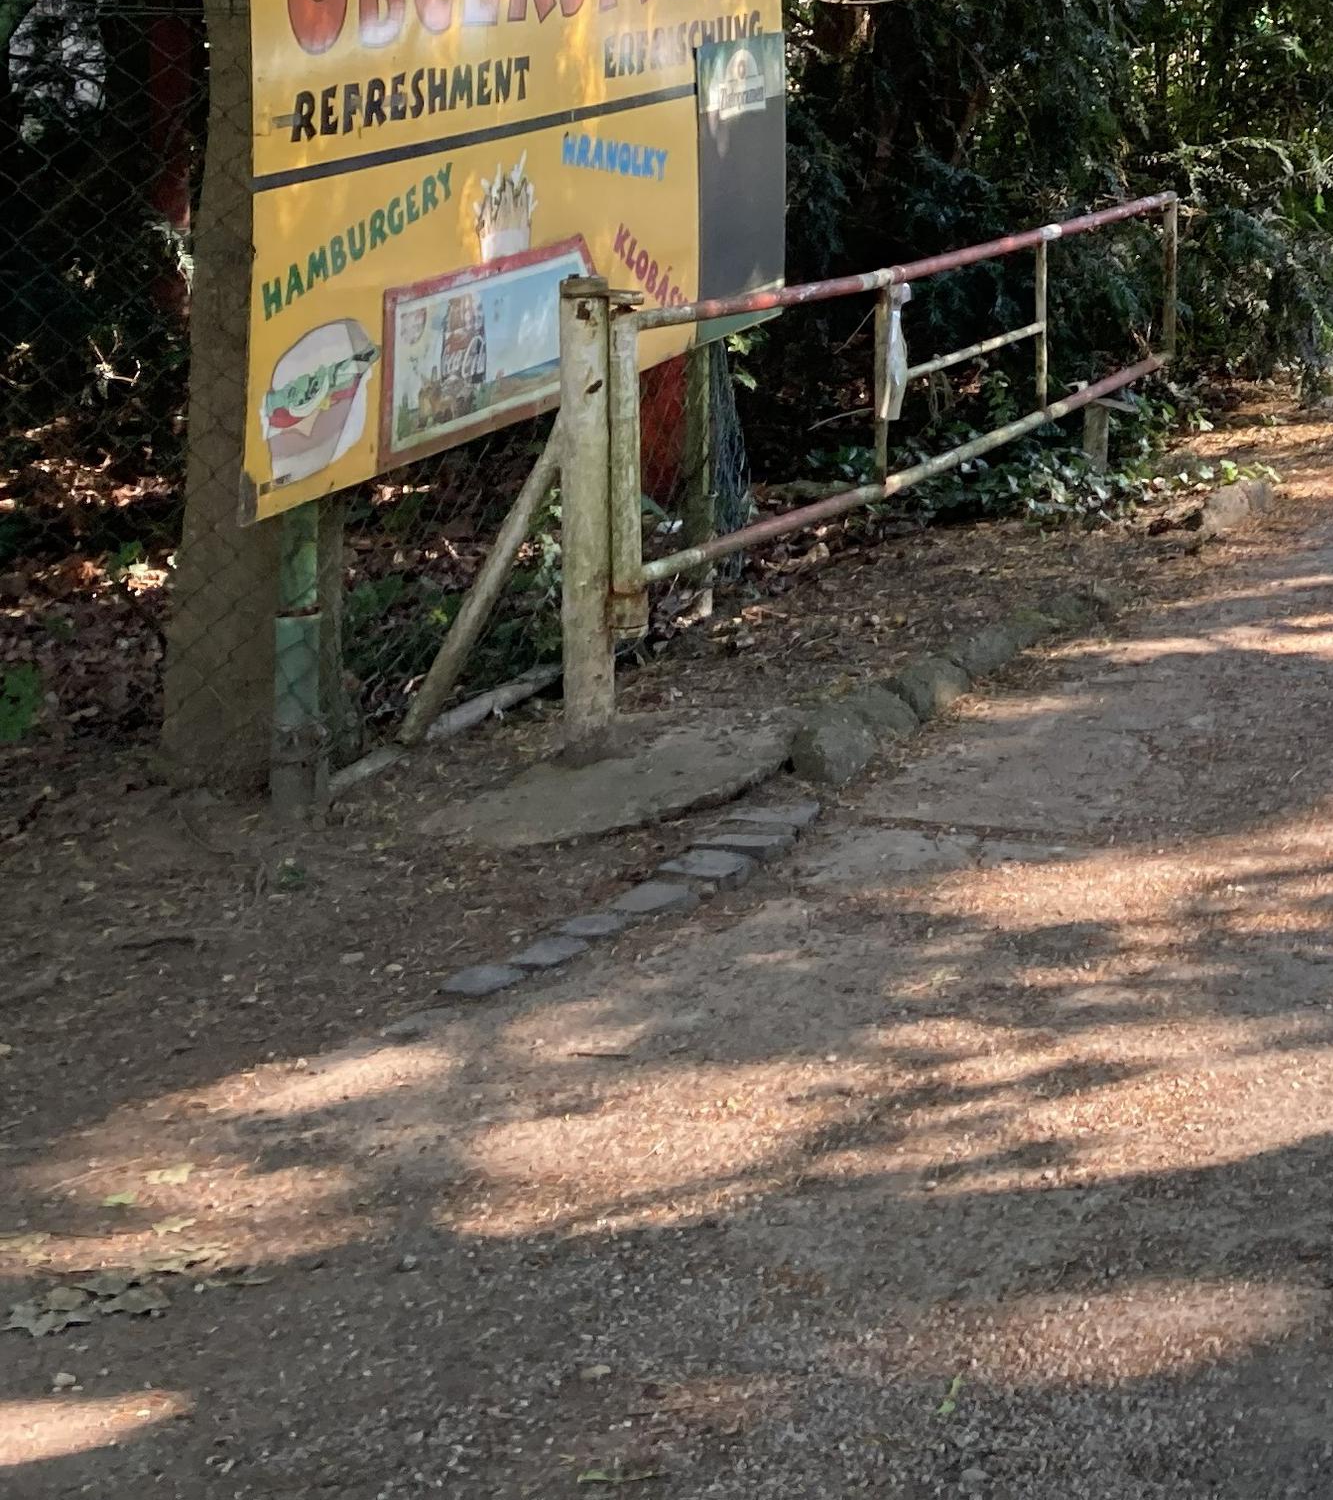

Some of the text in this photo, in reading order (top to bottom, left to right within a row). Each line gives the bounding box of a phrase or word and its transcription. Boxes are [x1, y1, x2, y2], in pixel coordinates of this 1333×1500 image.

[291, 56, 531, 143] REFRESHMENT
[562, 133, 668, 182] HRANOLKY
[262, 162, 453, 321] HAMBURGERY
[613, 222, 690, 308] KLOBÁS
